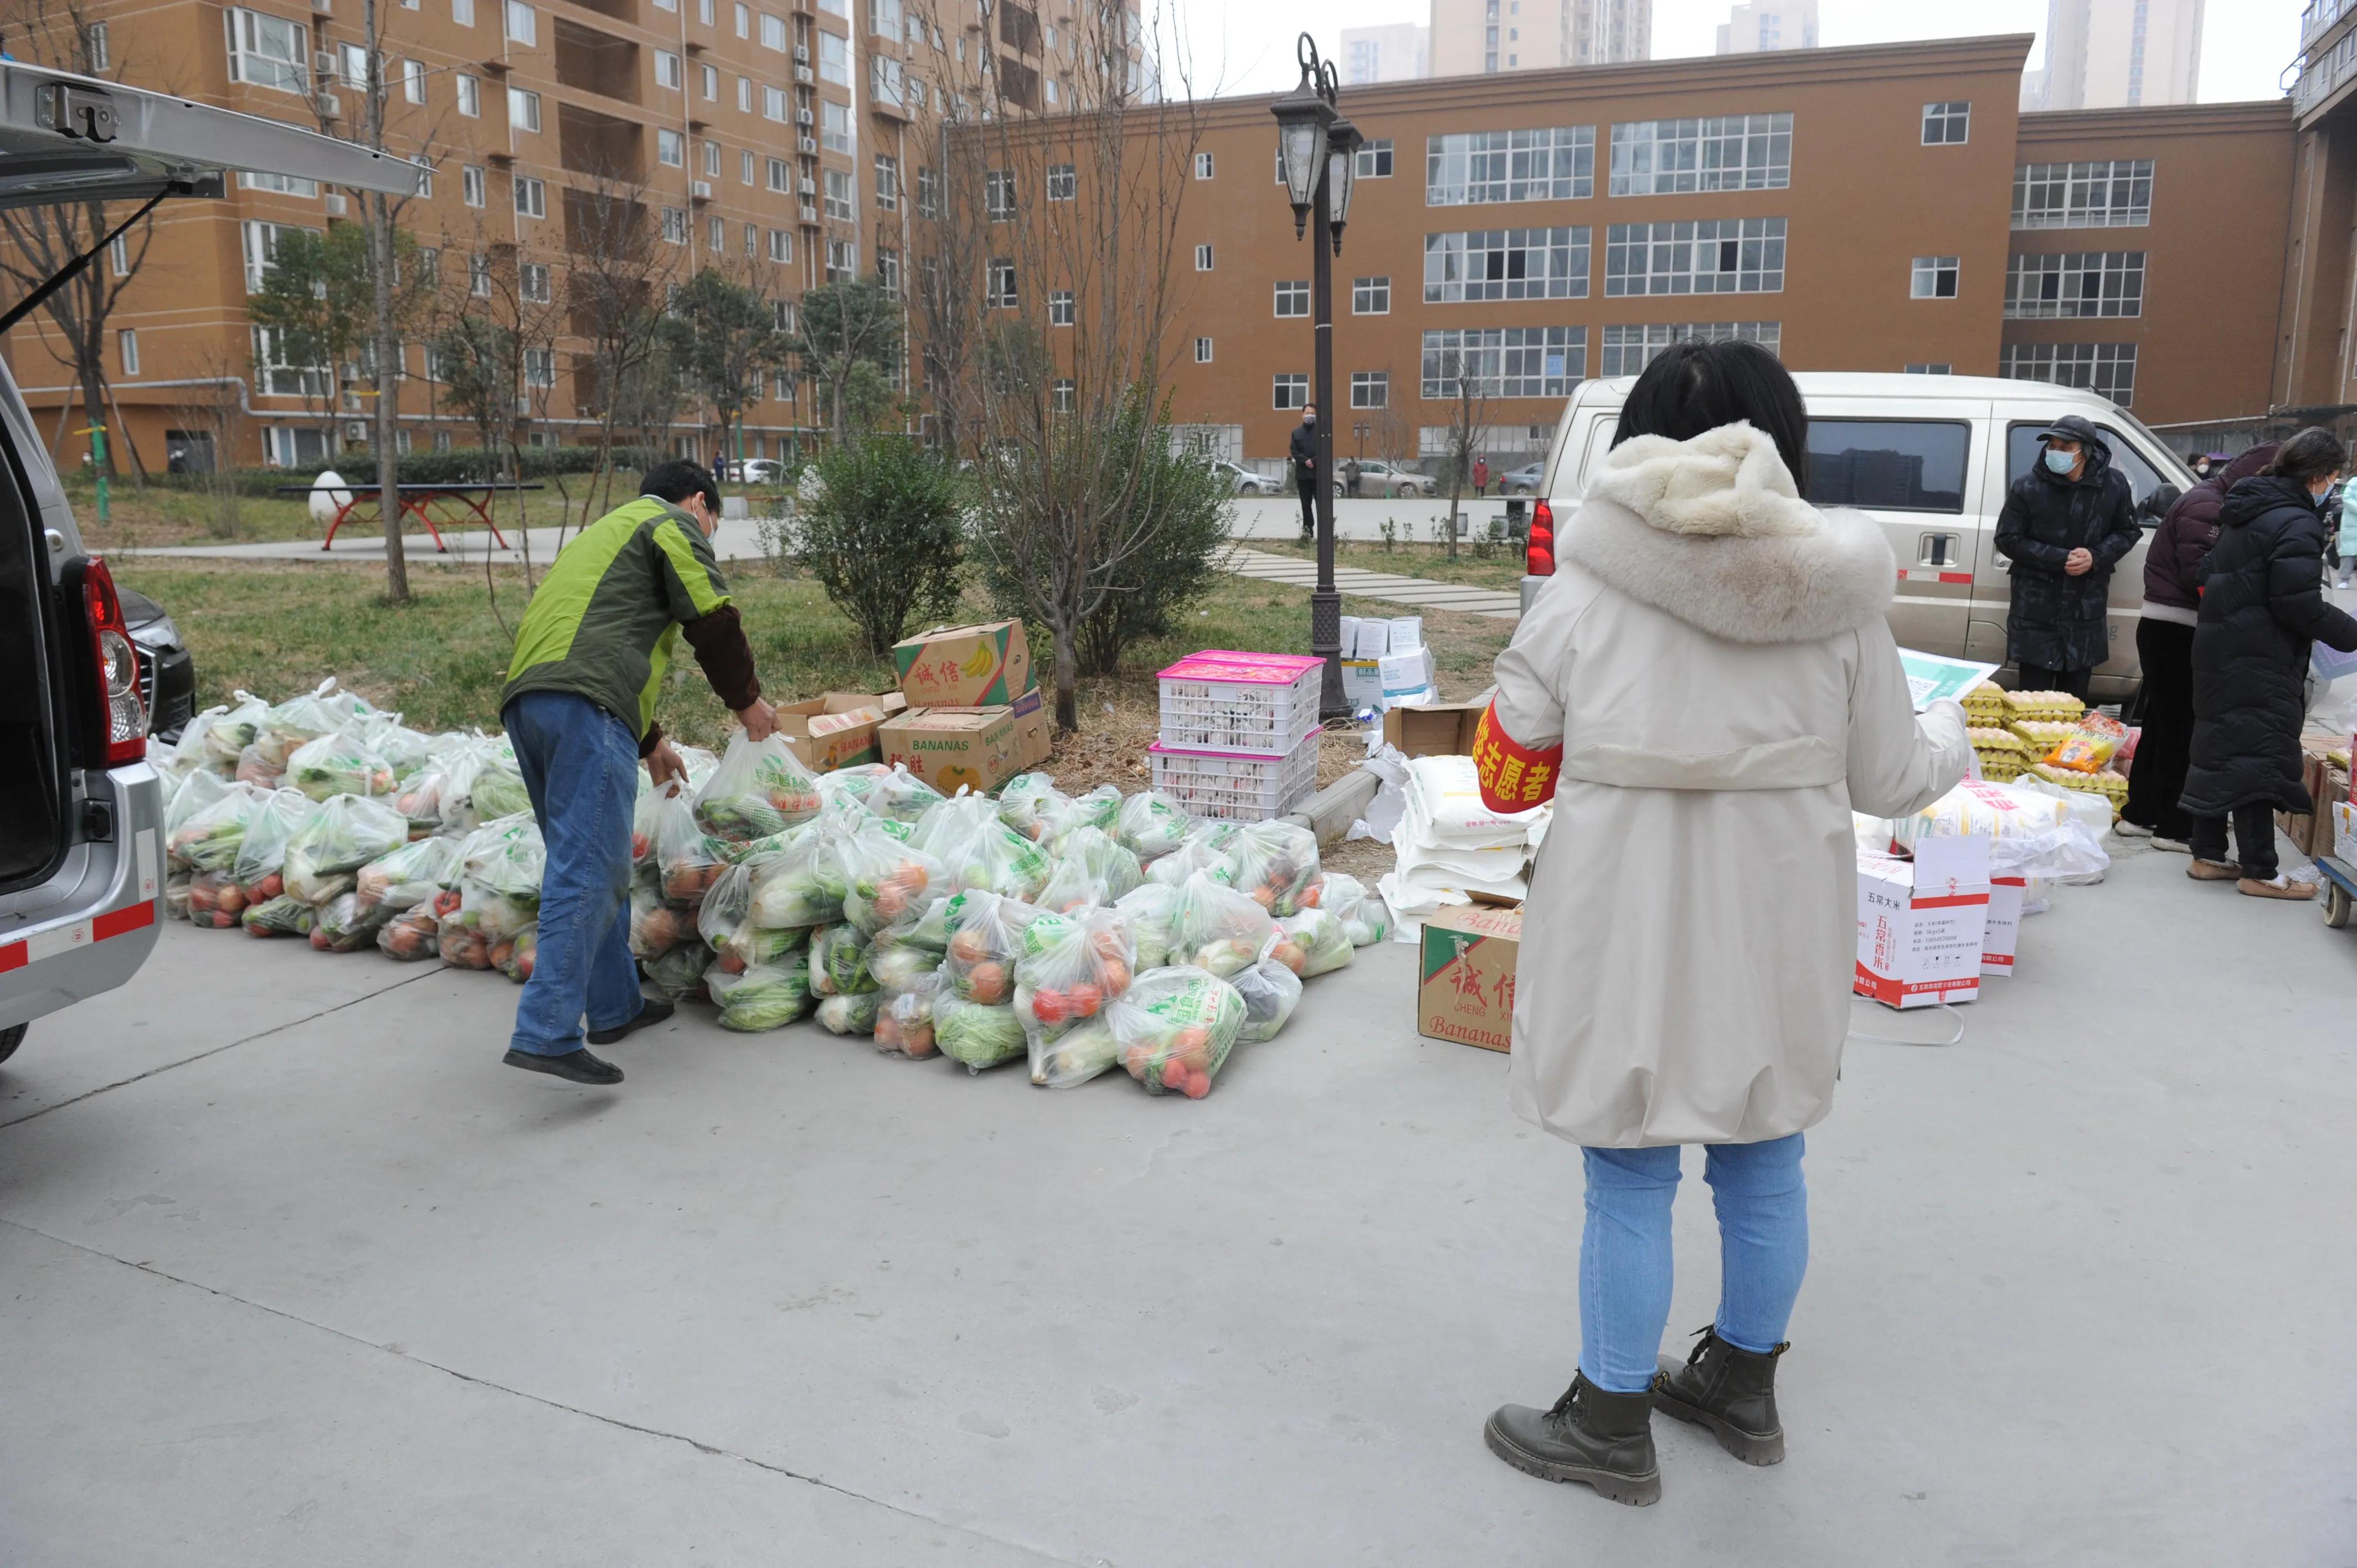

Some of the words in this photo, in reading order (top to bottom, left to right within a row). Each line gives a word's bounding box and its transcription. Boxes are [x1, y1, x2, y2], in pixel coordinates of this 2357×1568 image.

[915, 661, 960, 685] 诚信
[913, 740, 969, 751] BANANAS
[985, 721, 1015, 746] BANANAS
[1867, 892, 1901, 911] 五常大米
[1873, 914, 1888, 970] 五常香米
[1454, 1002, 1486, 1017] CHENG
[1429, 1015, 1512, 1048] Bananas
